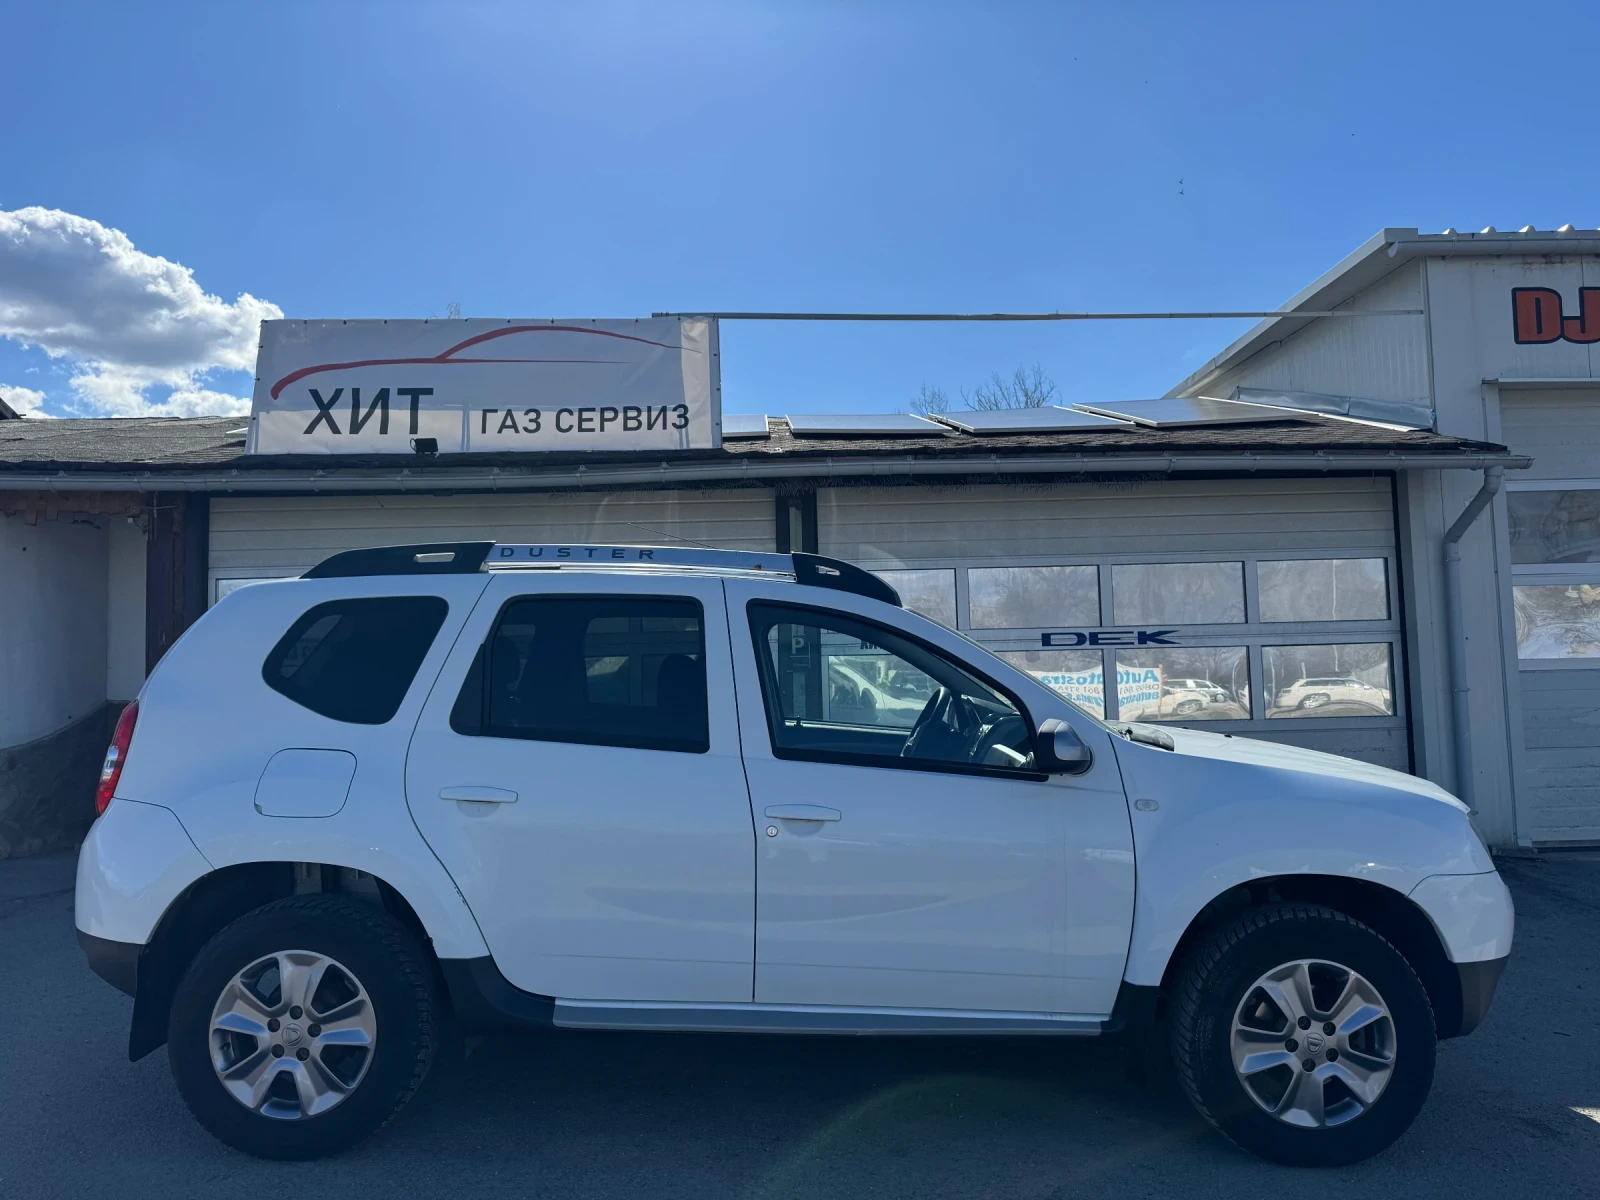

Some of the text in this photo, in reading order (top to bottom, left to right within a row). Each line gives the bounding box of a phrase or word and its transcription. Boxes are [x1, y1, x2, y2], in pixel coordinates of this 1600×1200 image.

[1511, 286, 1600, 344] DJ
[303, 388, 434, 434] ХИТ
[481, 403, 690, 434] ГАЗ СЕРВИЗ
[500, 547, 653, 559] DUSTER
[1041, 630, 1181, 646] DEK
